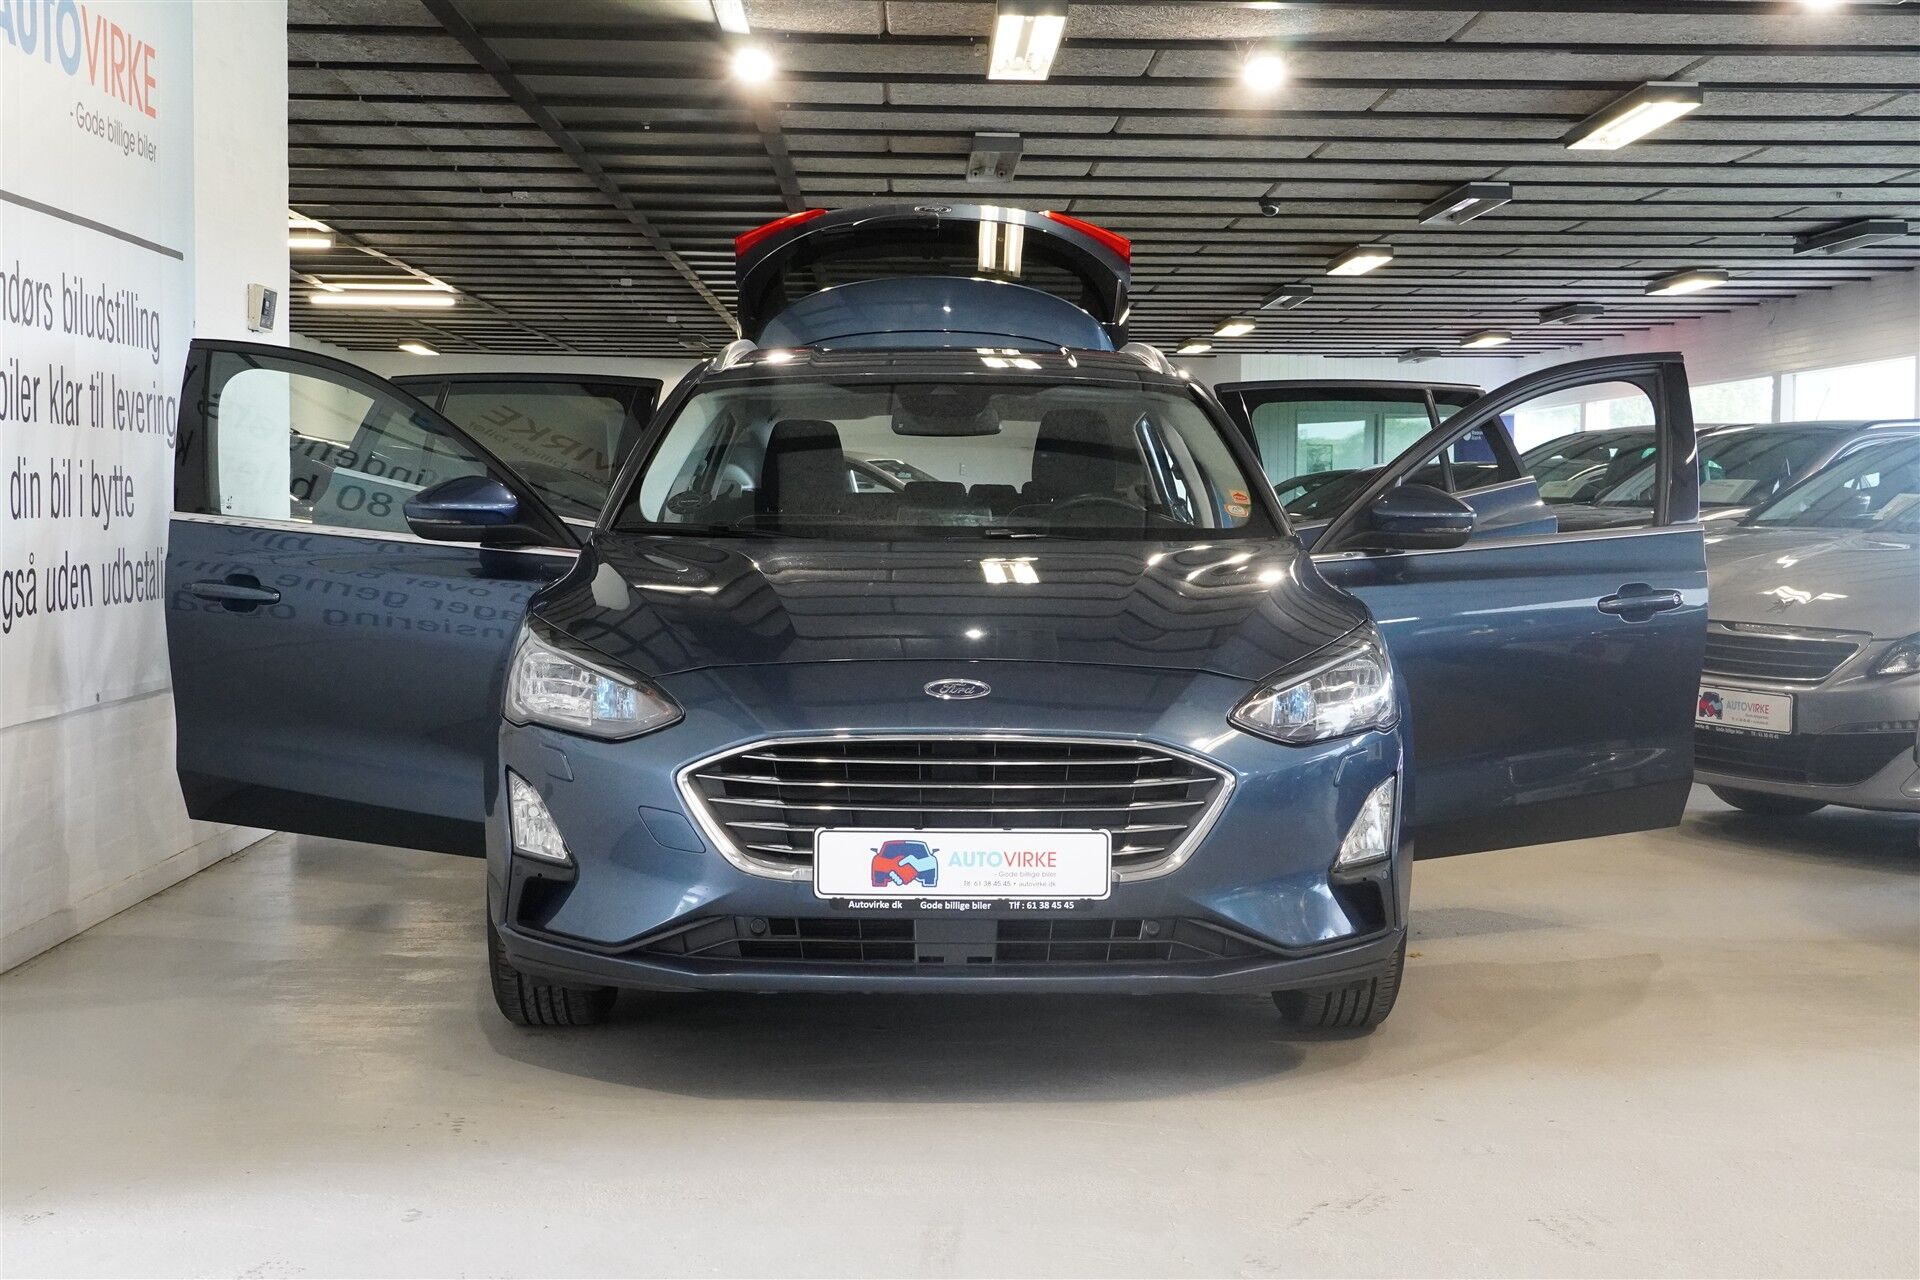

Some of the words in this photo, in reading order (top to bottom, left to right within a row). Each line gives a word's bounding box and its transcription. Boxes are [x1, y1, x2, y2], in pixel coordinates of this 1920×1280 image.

[76, 101, 105, 138] Gode
[107, 116, 136, 156] billige
[137, 130, 157, 163] biler
[62, 272, 160, 364] biludstilling
[49, 363, 83, 427] klar
[89, 371, 104, 428] til
[111, 373, 176, 449] levering
[10, 456, 41, 520] din
[50, 457, 71, 519] bil
[79, 459, 83, 518] i
[91, 459, 135, 531] bytte
[46, 550, 93, 614] uden
[939, 683, 975, 695] Ford
[1726, 701, 1769, 714] AUTOVIRKE
[948, 851, 1057, 868] AUTOVIRKE
[848, 901, 890, 909] Autovirke
[891, 901, 903, 909] dk
[920, 901, 943, 910] Gode
[944, 901, 970, 911] billige
[971, 901, 992, 910] biler
[1026, 901, 1037, 909] 61
[1039, 901, 1050, 909] 38
[1051, 901, 1062, 909] 45
[1063, 901, 1075, 909] 45
